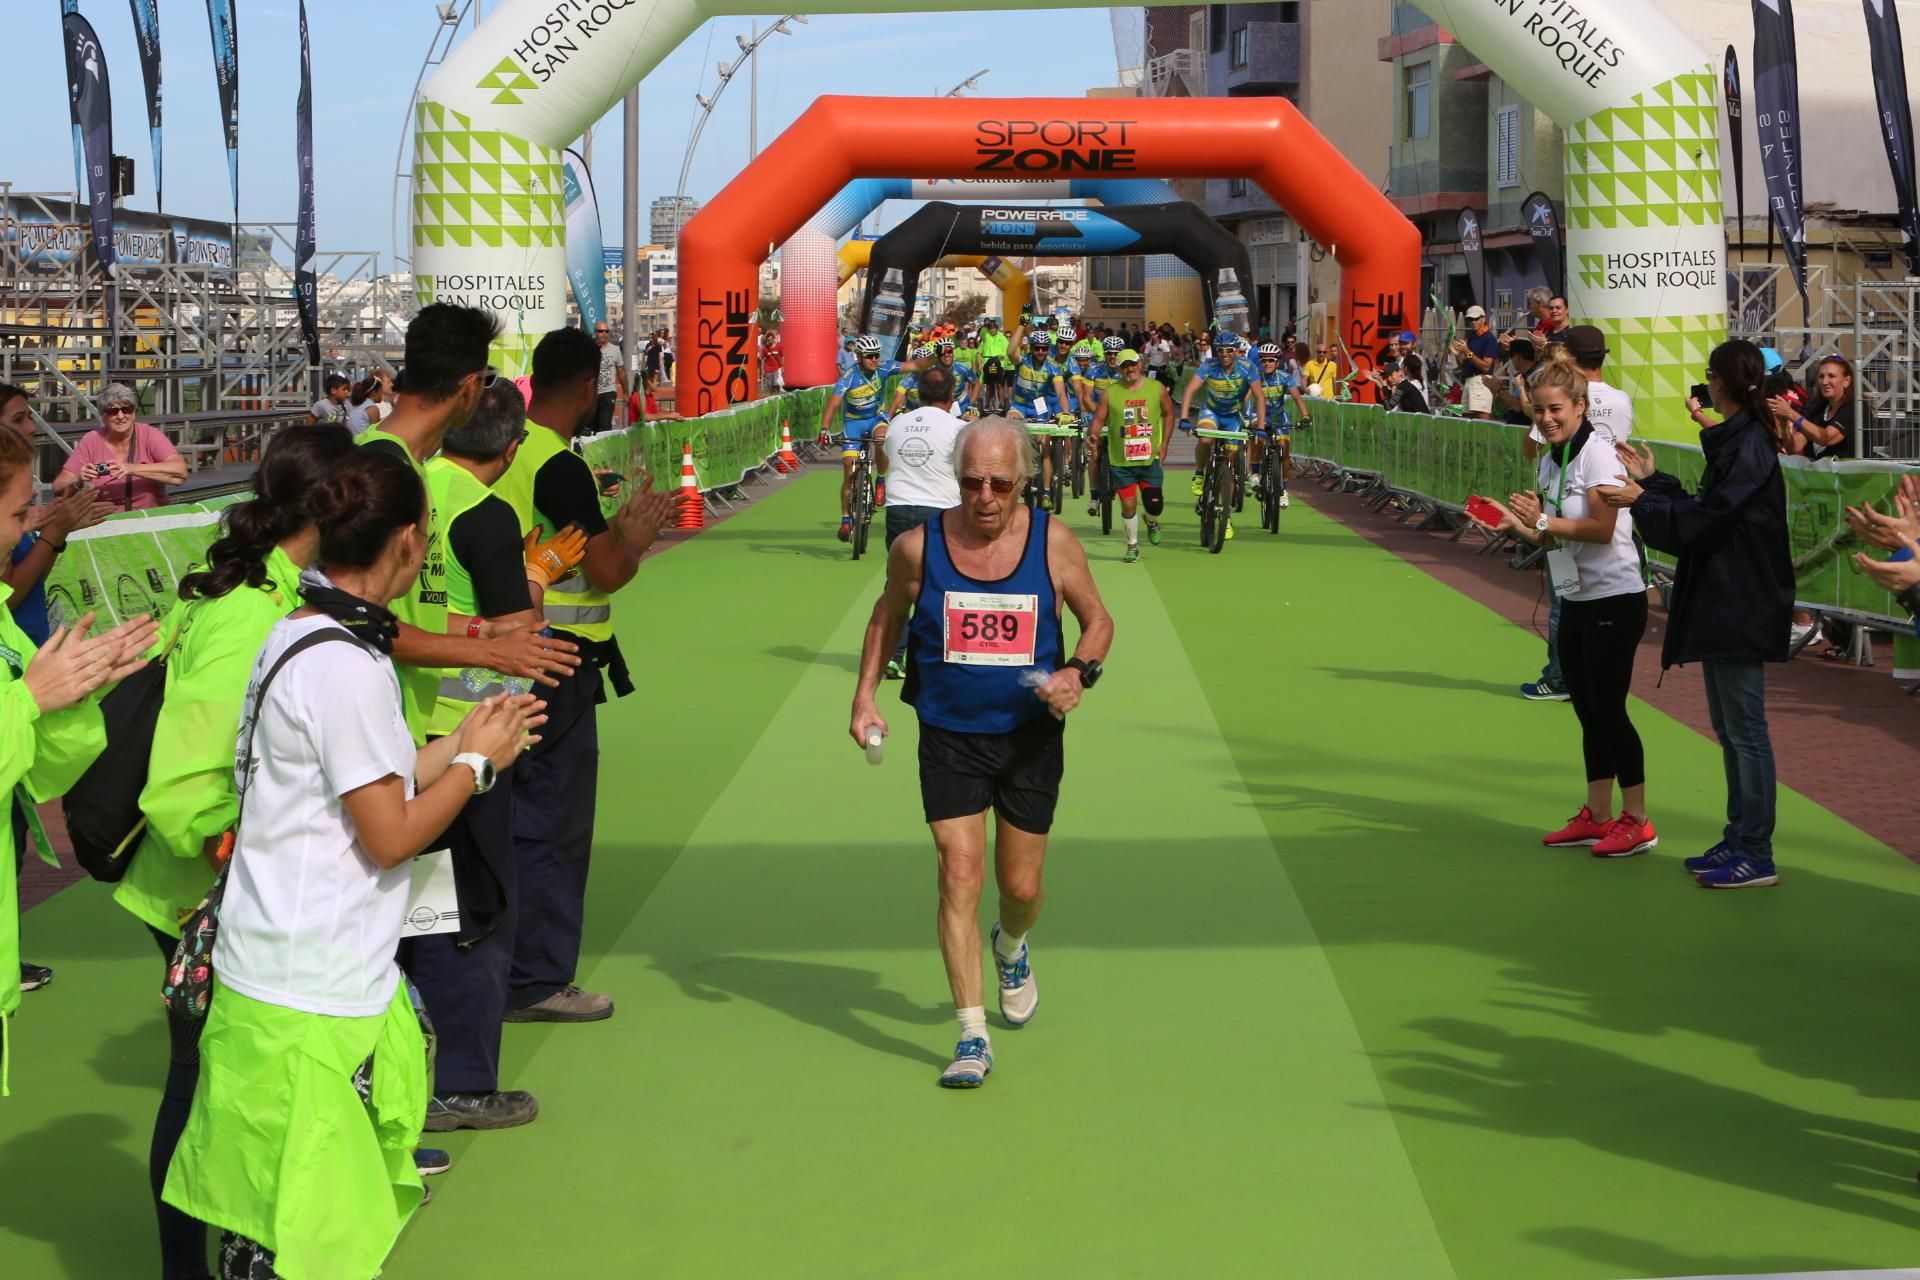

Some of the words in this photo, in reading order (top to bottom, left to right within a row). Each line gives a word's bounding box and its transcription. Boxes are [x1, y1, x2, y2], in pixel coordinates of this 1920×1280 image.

[513, 0, 590, 63] HOSPI
[532, 36, 579, 82] SAN
[1523, 12, 1606, 88] ROQUE
[975, 120, 1138, 146] SPORT
[974, 149, 1137, 172] ZONE
[981, 209, 1090, 220] POWERADE
[981, 240, 1011, 249] bebida
[1035, 242, 1087, 251] deportistas
[1607, 250, 1716, 269] HOSPITALES
[436, 275, 545, 290] HOSPITALES
[1608, 273, 1647, 289] SAN
[1657, 270, 1716, 289] ROQUE
[480, 295, 545, 310] ROQUE
[697, 287, 724, 417] PORT
[726, 288, 749, 405] ONE
[904, 425, 932, 433] STAFF
[1128, 443, 1147, 454] 274
[961, 613, 1018, 641] 589
